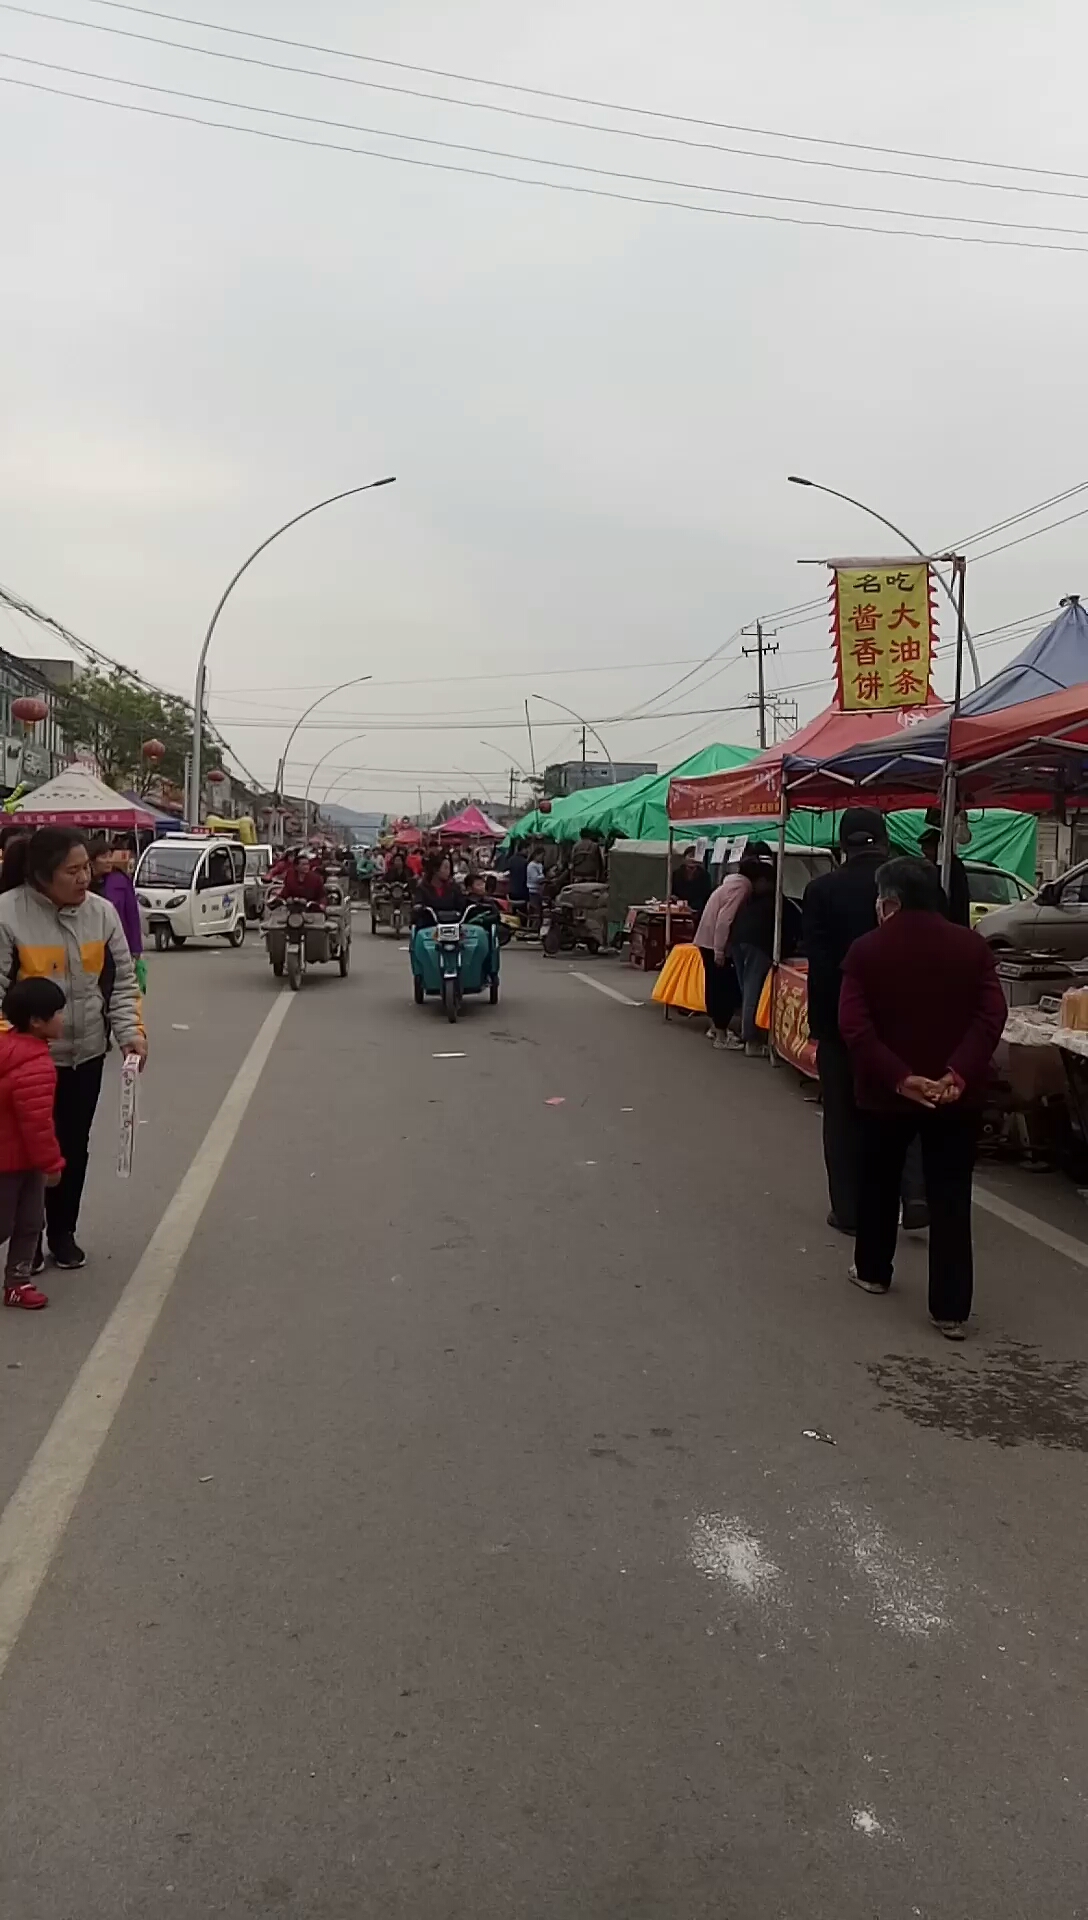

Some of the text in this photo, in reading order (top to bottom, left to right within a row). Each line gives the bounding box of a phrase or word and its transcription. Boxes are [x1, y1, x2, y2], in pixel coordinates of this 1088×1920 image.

[853, 572, 915, 594] 名吃
[848, 603, 884, 701] 酱香饼
[887, 602, 924, 696] 大油条
